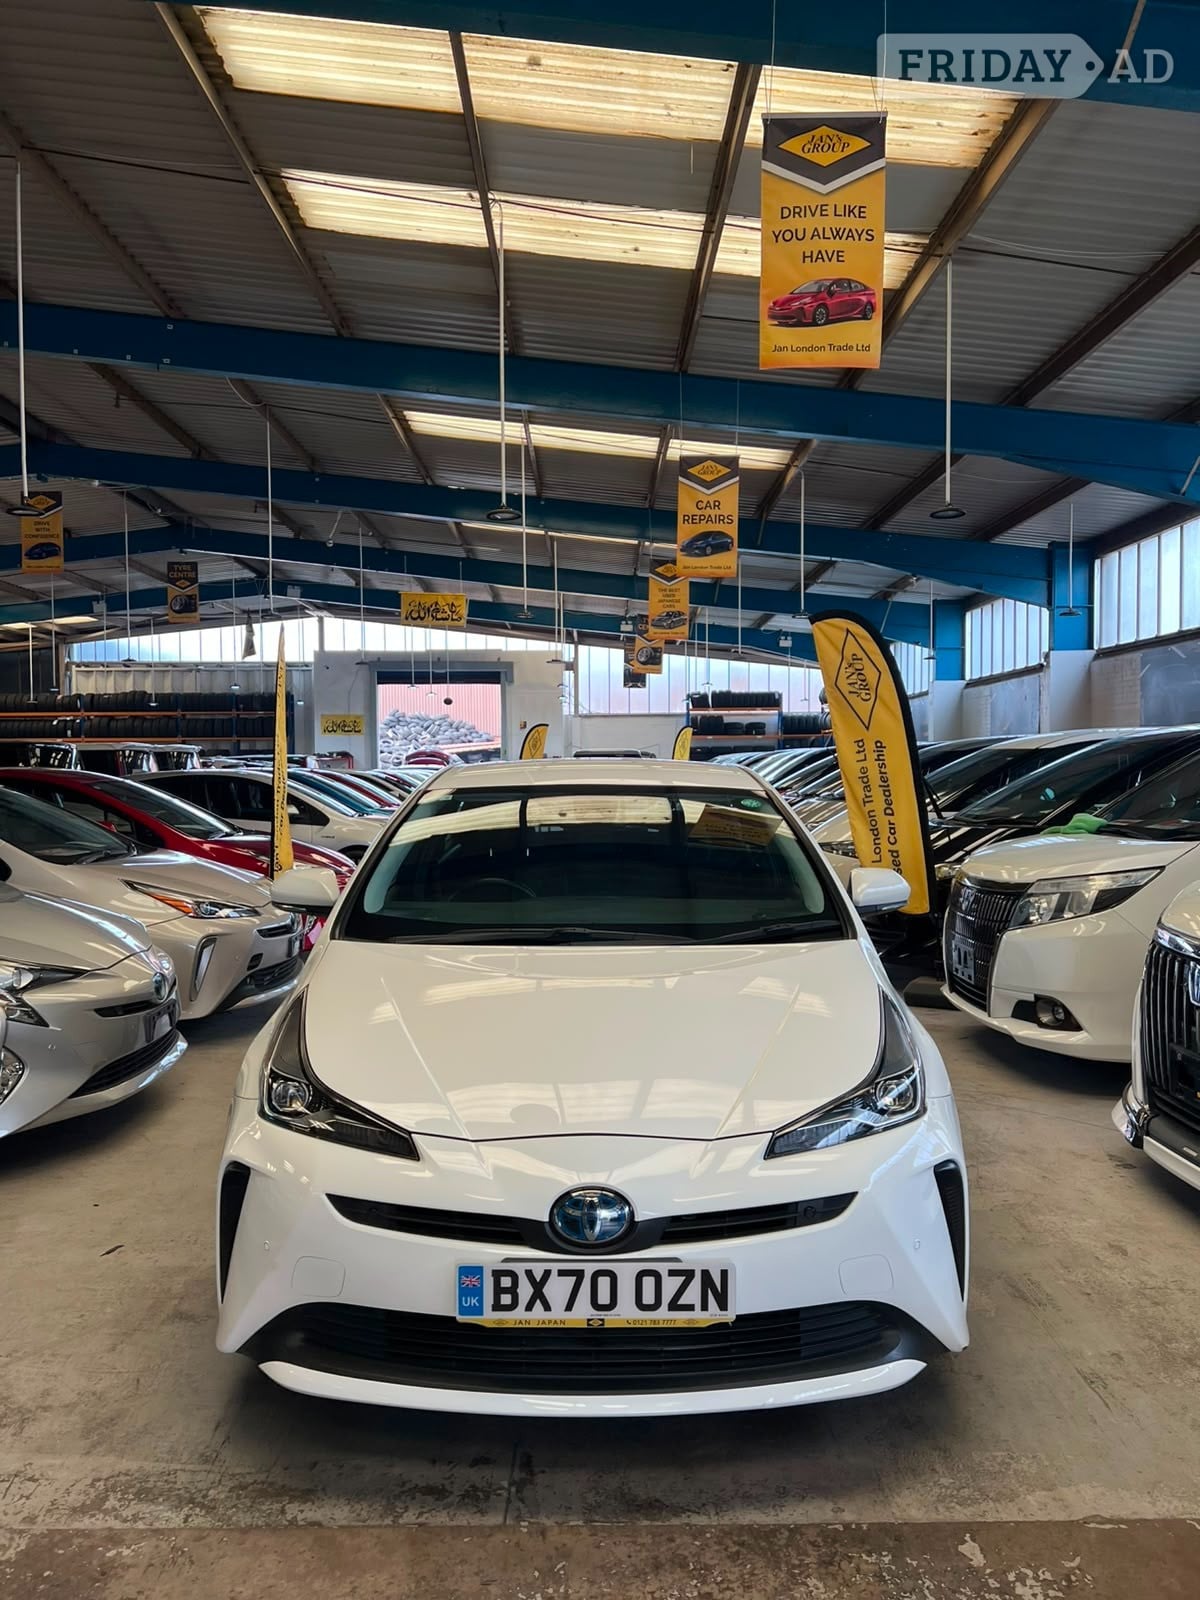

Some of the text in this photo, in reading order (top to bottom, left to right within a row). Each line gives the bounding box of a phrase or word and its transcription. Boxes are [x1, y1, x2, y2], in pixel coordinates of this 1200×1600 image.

[801, 141, 850, 154] GROUP
[780, 204, 867, 220] DRIVE LIKE
[772, 227, 875, 243] YOU ALWAYS
[802, 249, 845, 263] HAVE
[772, 343, 871, 352] Jan London Trade Ltd
[695, 500, 721, 511] CAR
[682, 514, 734, 525] REPAIRS
[852, 653, 871, 702] GROUP
[854, 738, 882, 863] London Trade Ltd
[873, 740, 903, 875] sed Car Dealership
[491, 1268, 729, 1312] BX70 OZN
[462, 1296, 480, 1307] UK
